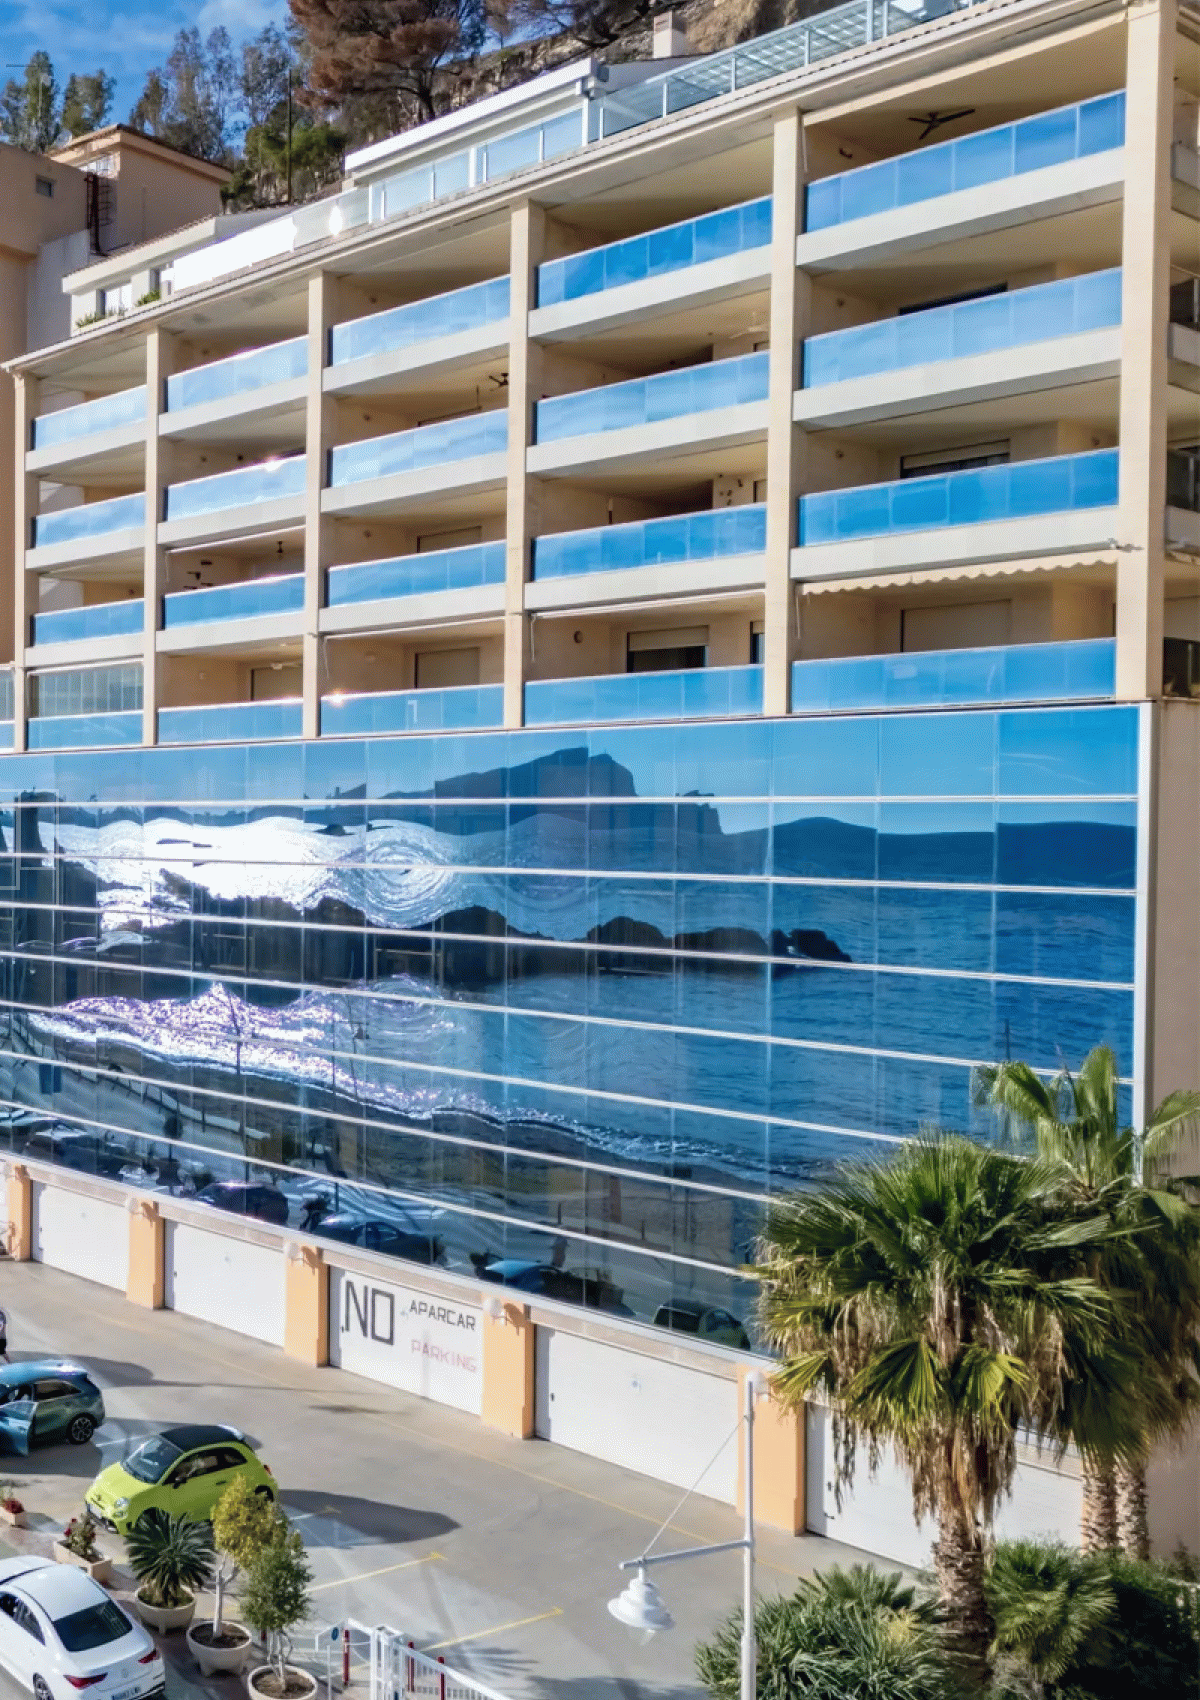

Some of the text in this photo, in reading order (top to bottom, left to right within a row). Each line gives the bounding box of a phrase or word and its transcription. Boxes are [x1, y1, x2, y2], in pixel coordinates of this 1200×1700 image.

[345, 1280, 476, 1345] NO APARCAR
[410, 1338, 477, 1373] PARKING
